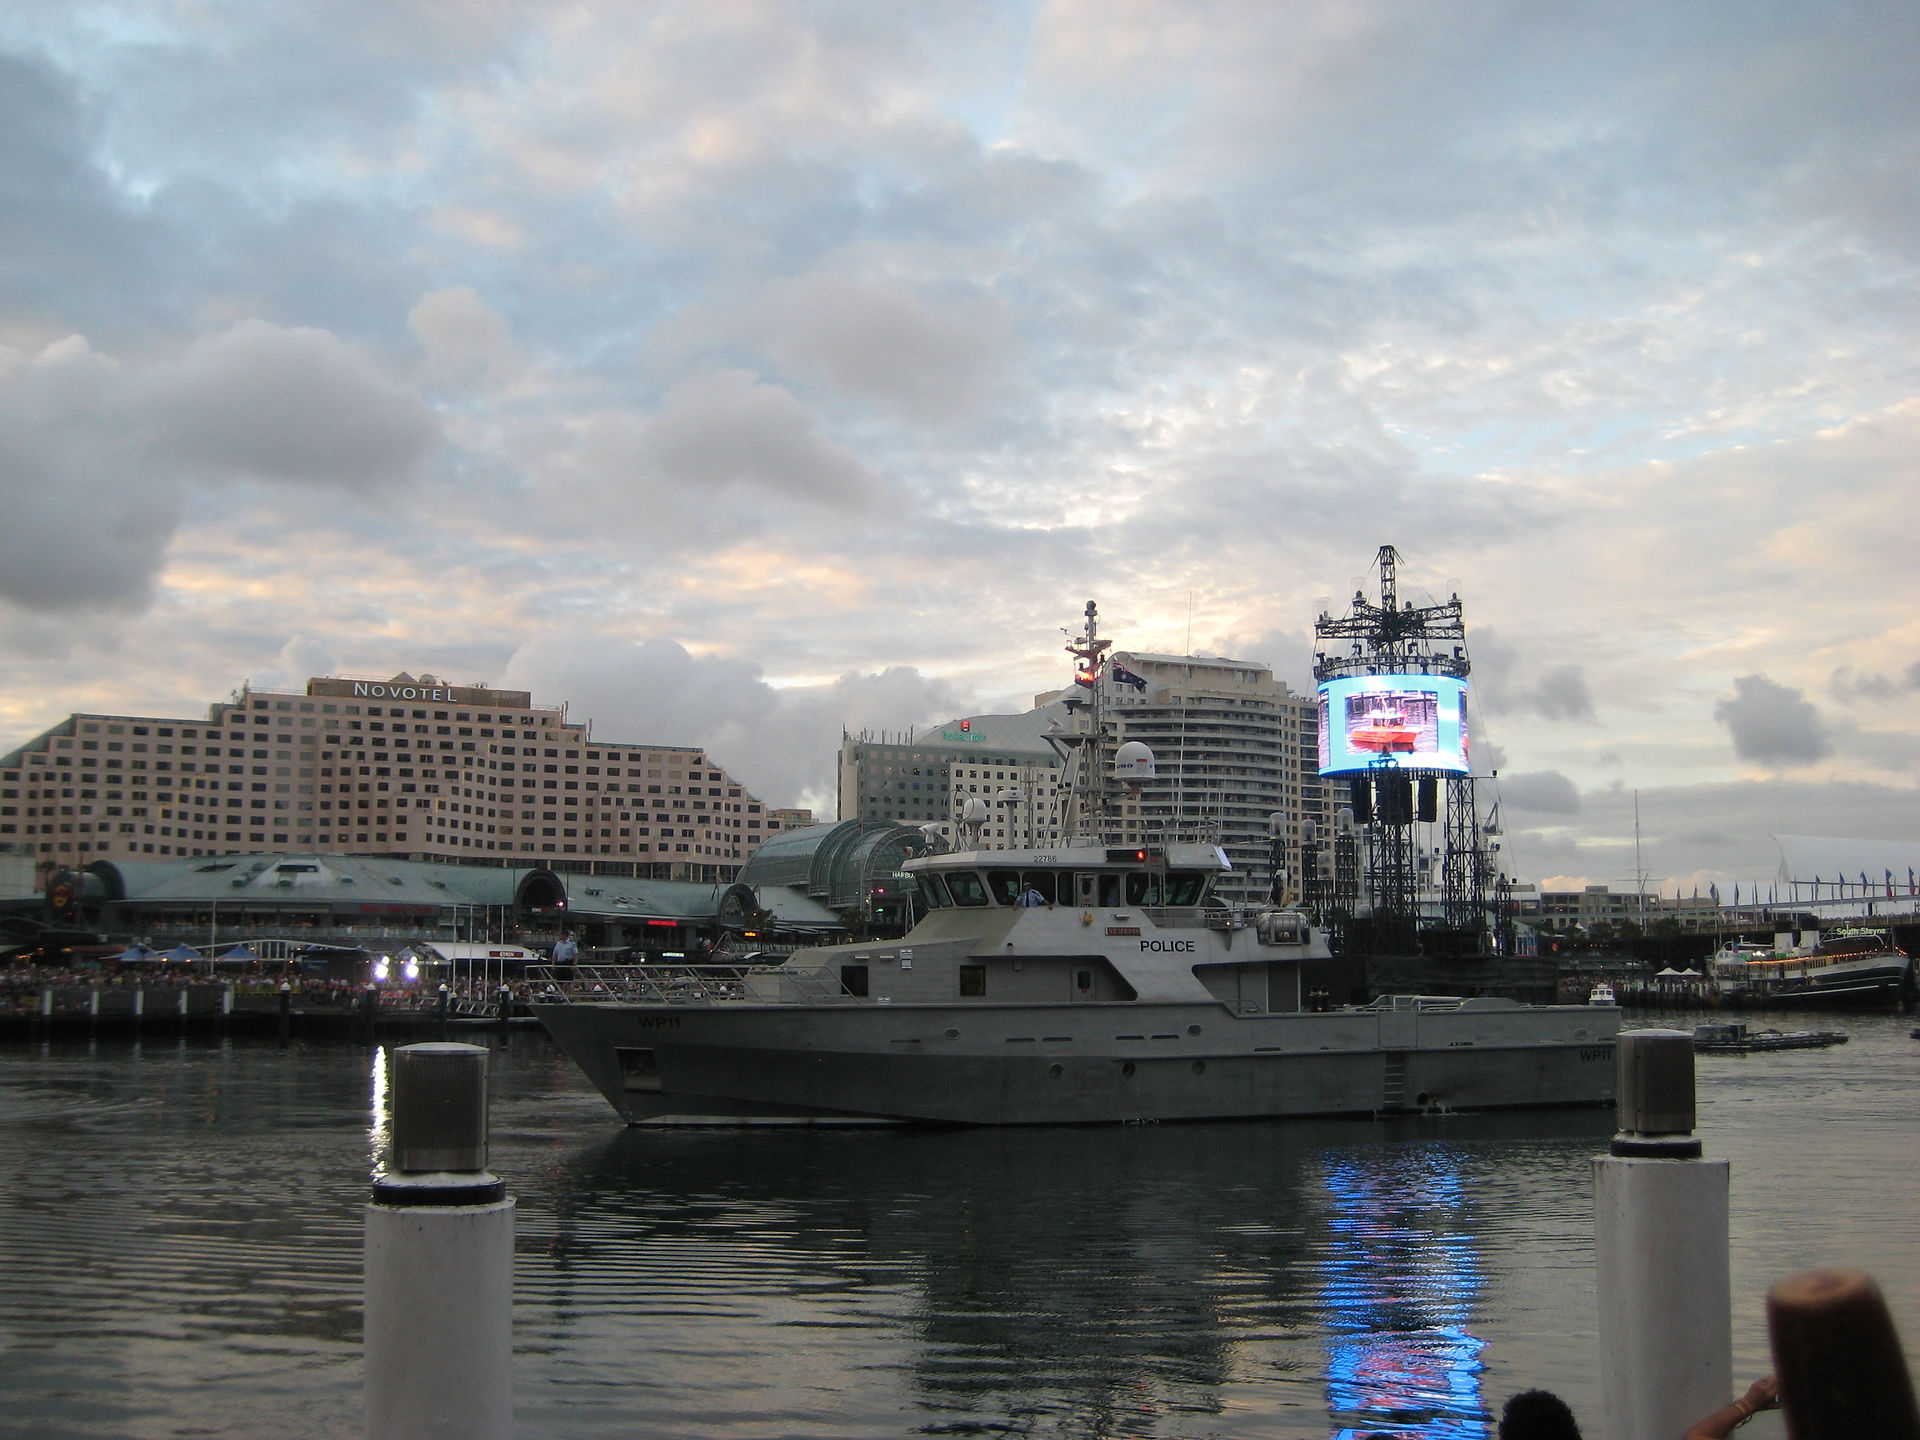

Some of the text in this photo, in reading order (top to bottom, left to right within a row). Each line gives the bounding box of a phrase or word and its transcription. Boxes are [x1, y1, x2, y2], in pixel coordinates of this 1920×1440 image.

[354, 681, 457, 702] NOVOTEL
[1033, 855, 1057, 863] 22786
[1836, 927, 1859, 936] South
[1140, 940, 1195, 952] POLICE
[638, 1016, 681, 1029] WP11
[1580, 1049, 1611, 1061] WP11
